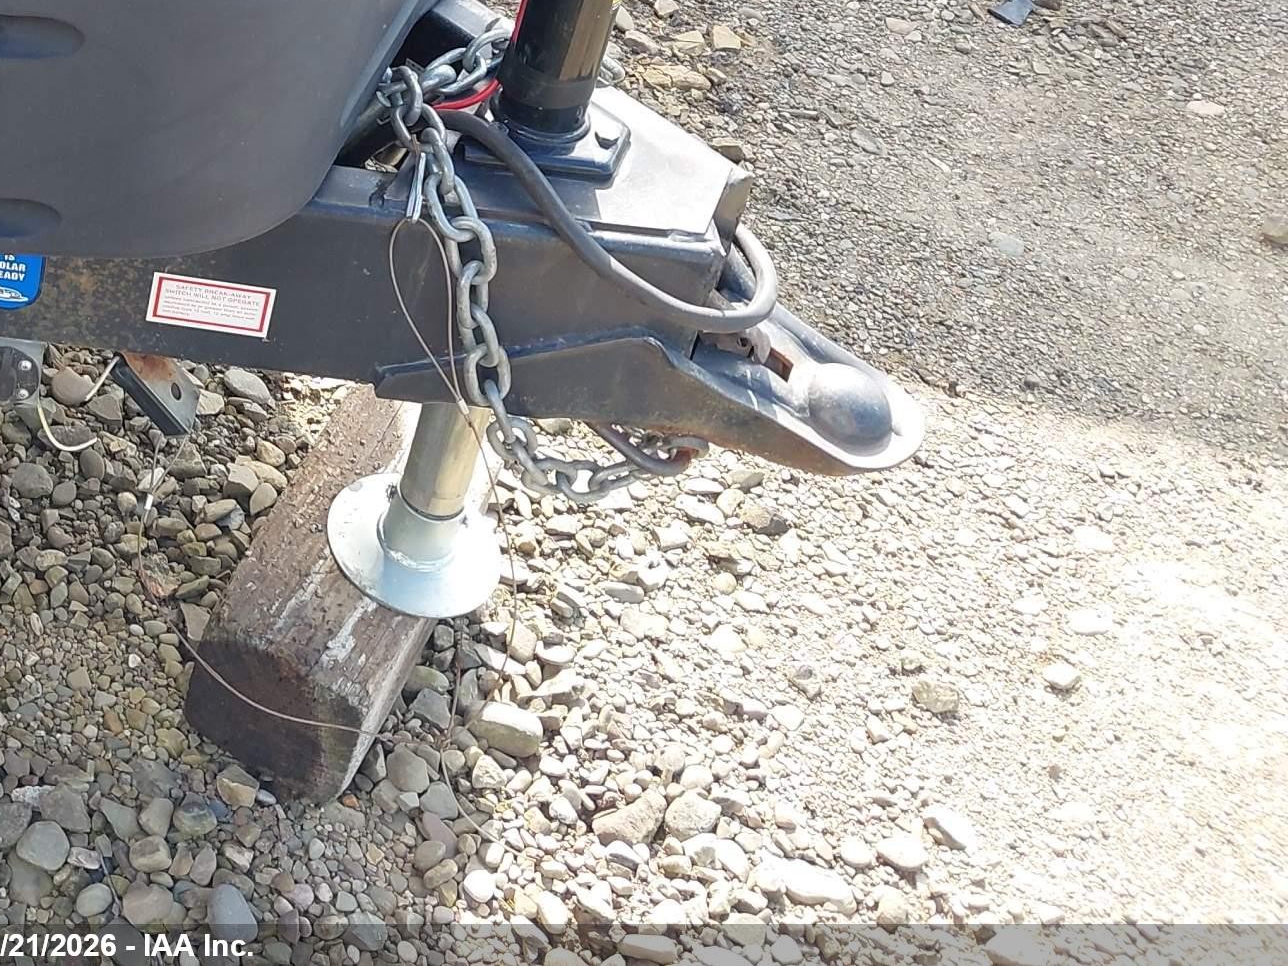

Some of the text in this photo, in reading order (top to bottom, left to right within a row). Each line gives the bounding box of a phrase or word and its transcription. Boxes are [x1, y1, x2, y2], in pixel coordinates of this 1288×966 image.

[175, 284, 203, 293] SAFETY
[165, 288, 192, 297] SWITCH
[193, 292, 210, 300] WILL
[211, 295, 227, 303] NOT
[228, 297, 261, 307] OPERATE
